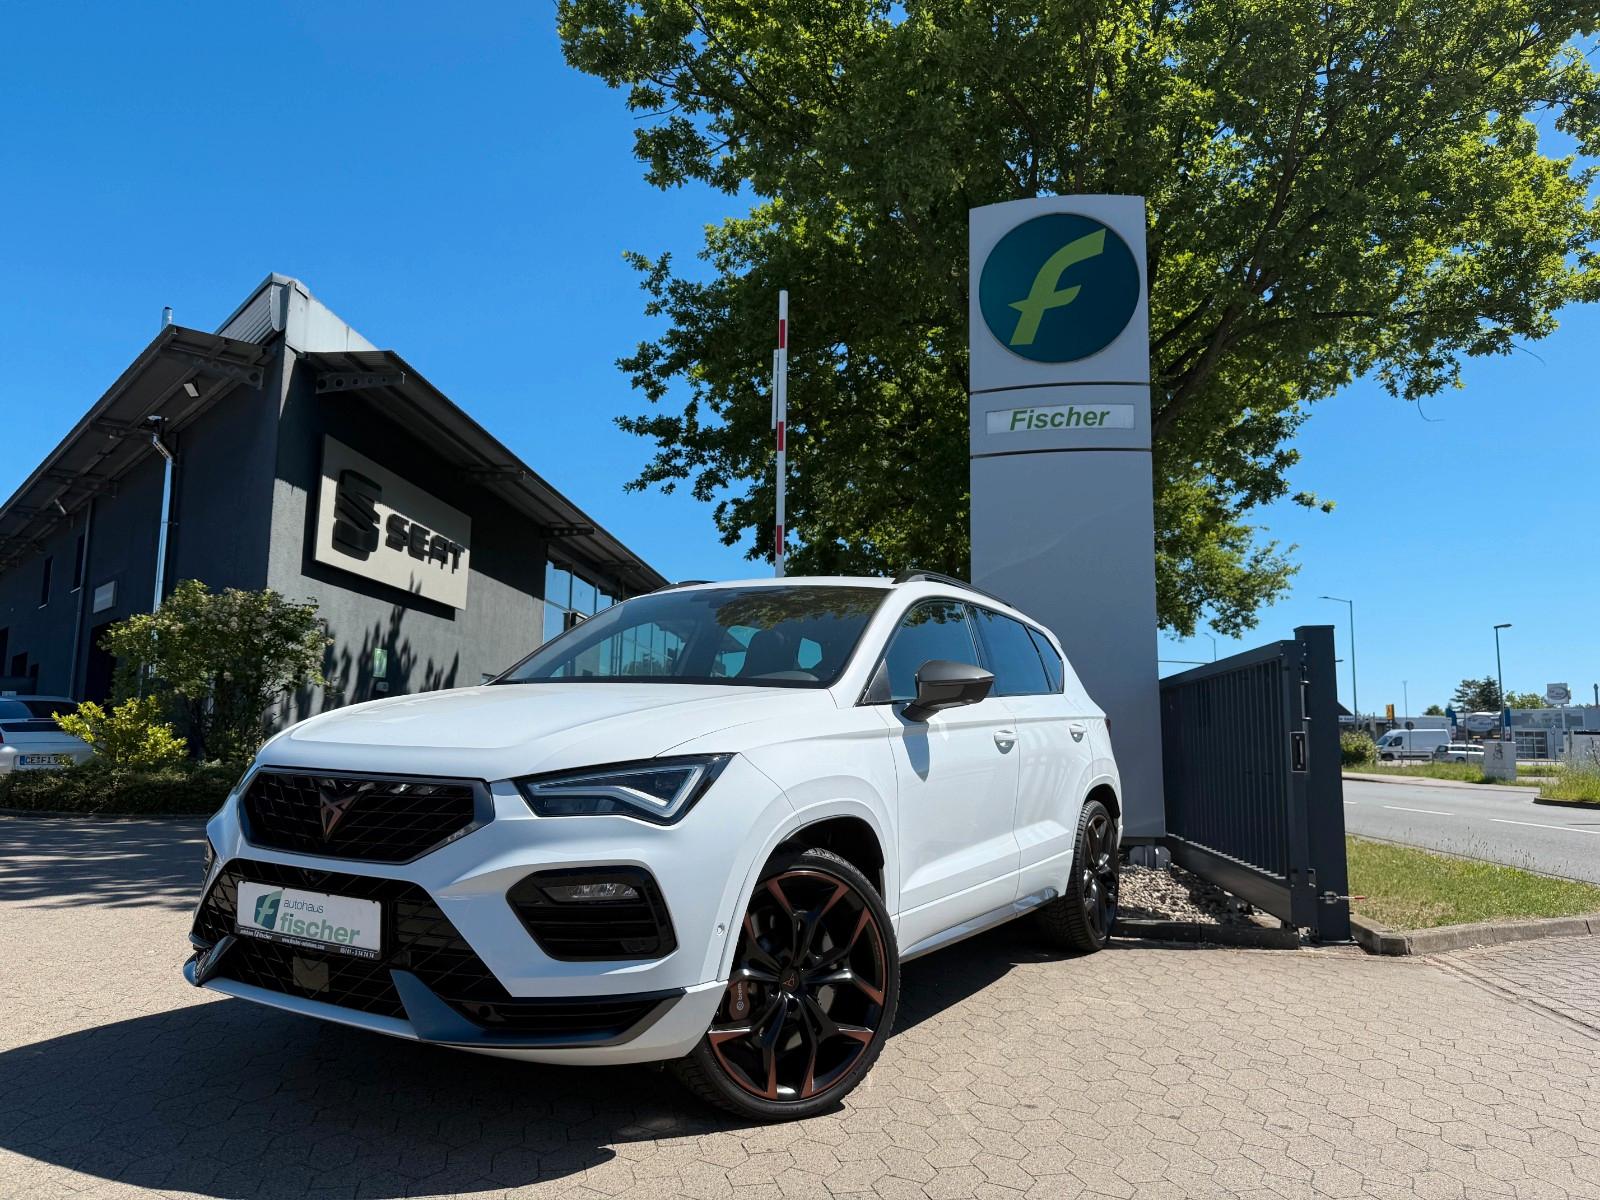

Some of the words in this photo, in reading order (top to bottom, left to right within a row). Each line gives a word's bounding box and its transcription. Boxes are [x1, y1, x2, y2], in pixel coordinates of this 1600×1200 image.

[1009, 406, 1111, 431] Fischer
[385, 513, 466, 572] SEAT
[284, 899, 324, 914] autohaus
[280, 913, 360, 945] fischer
